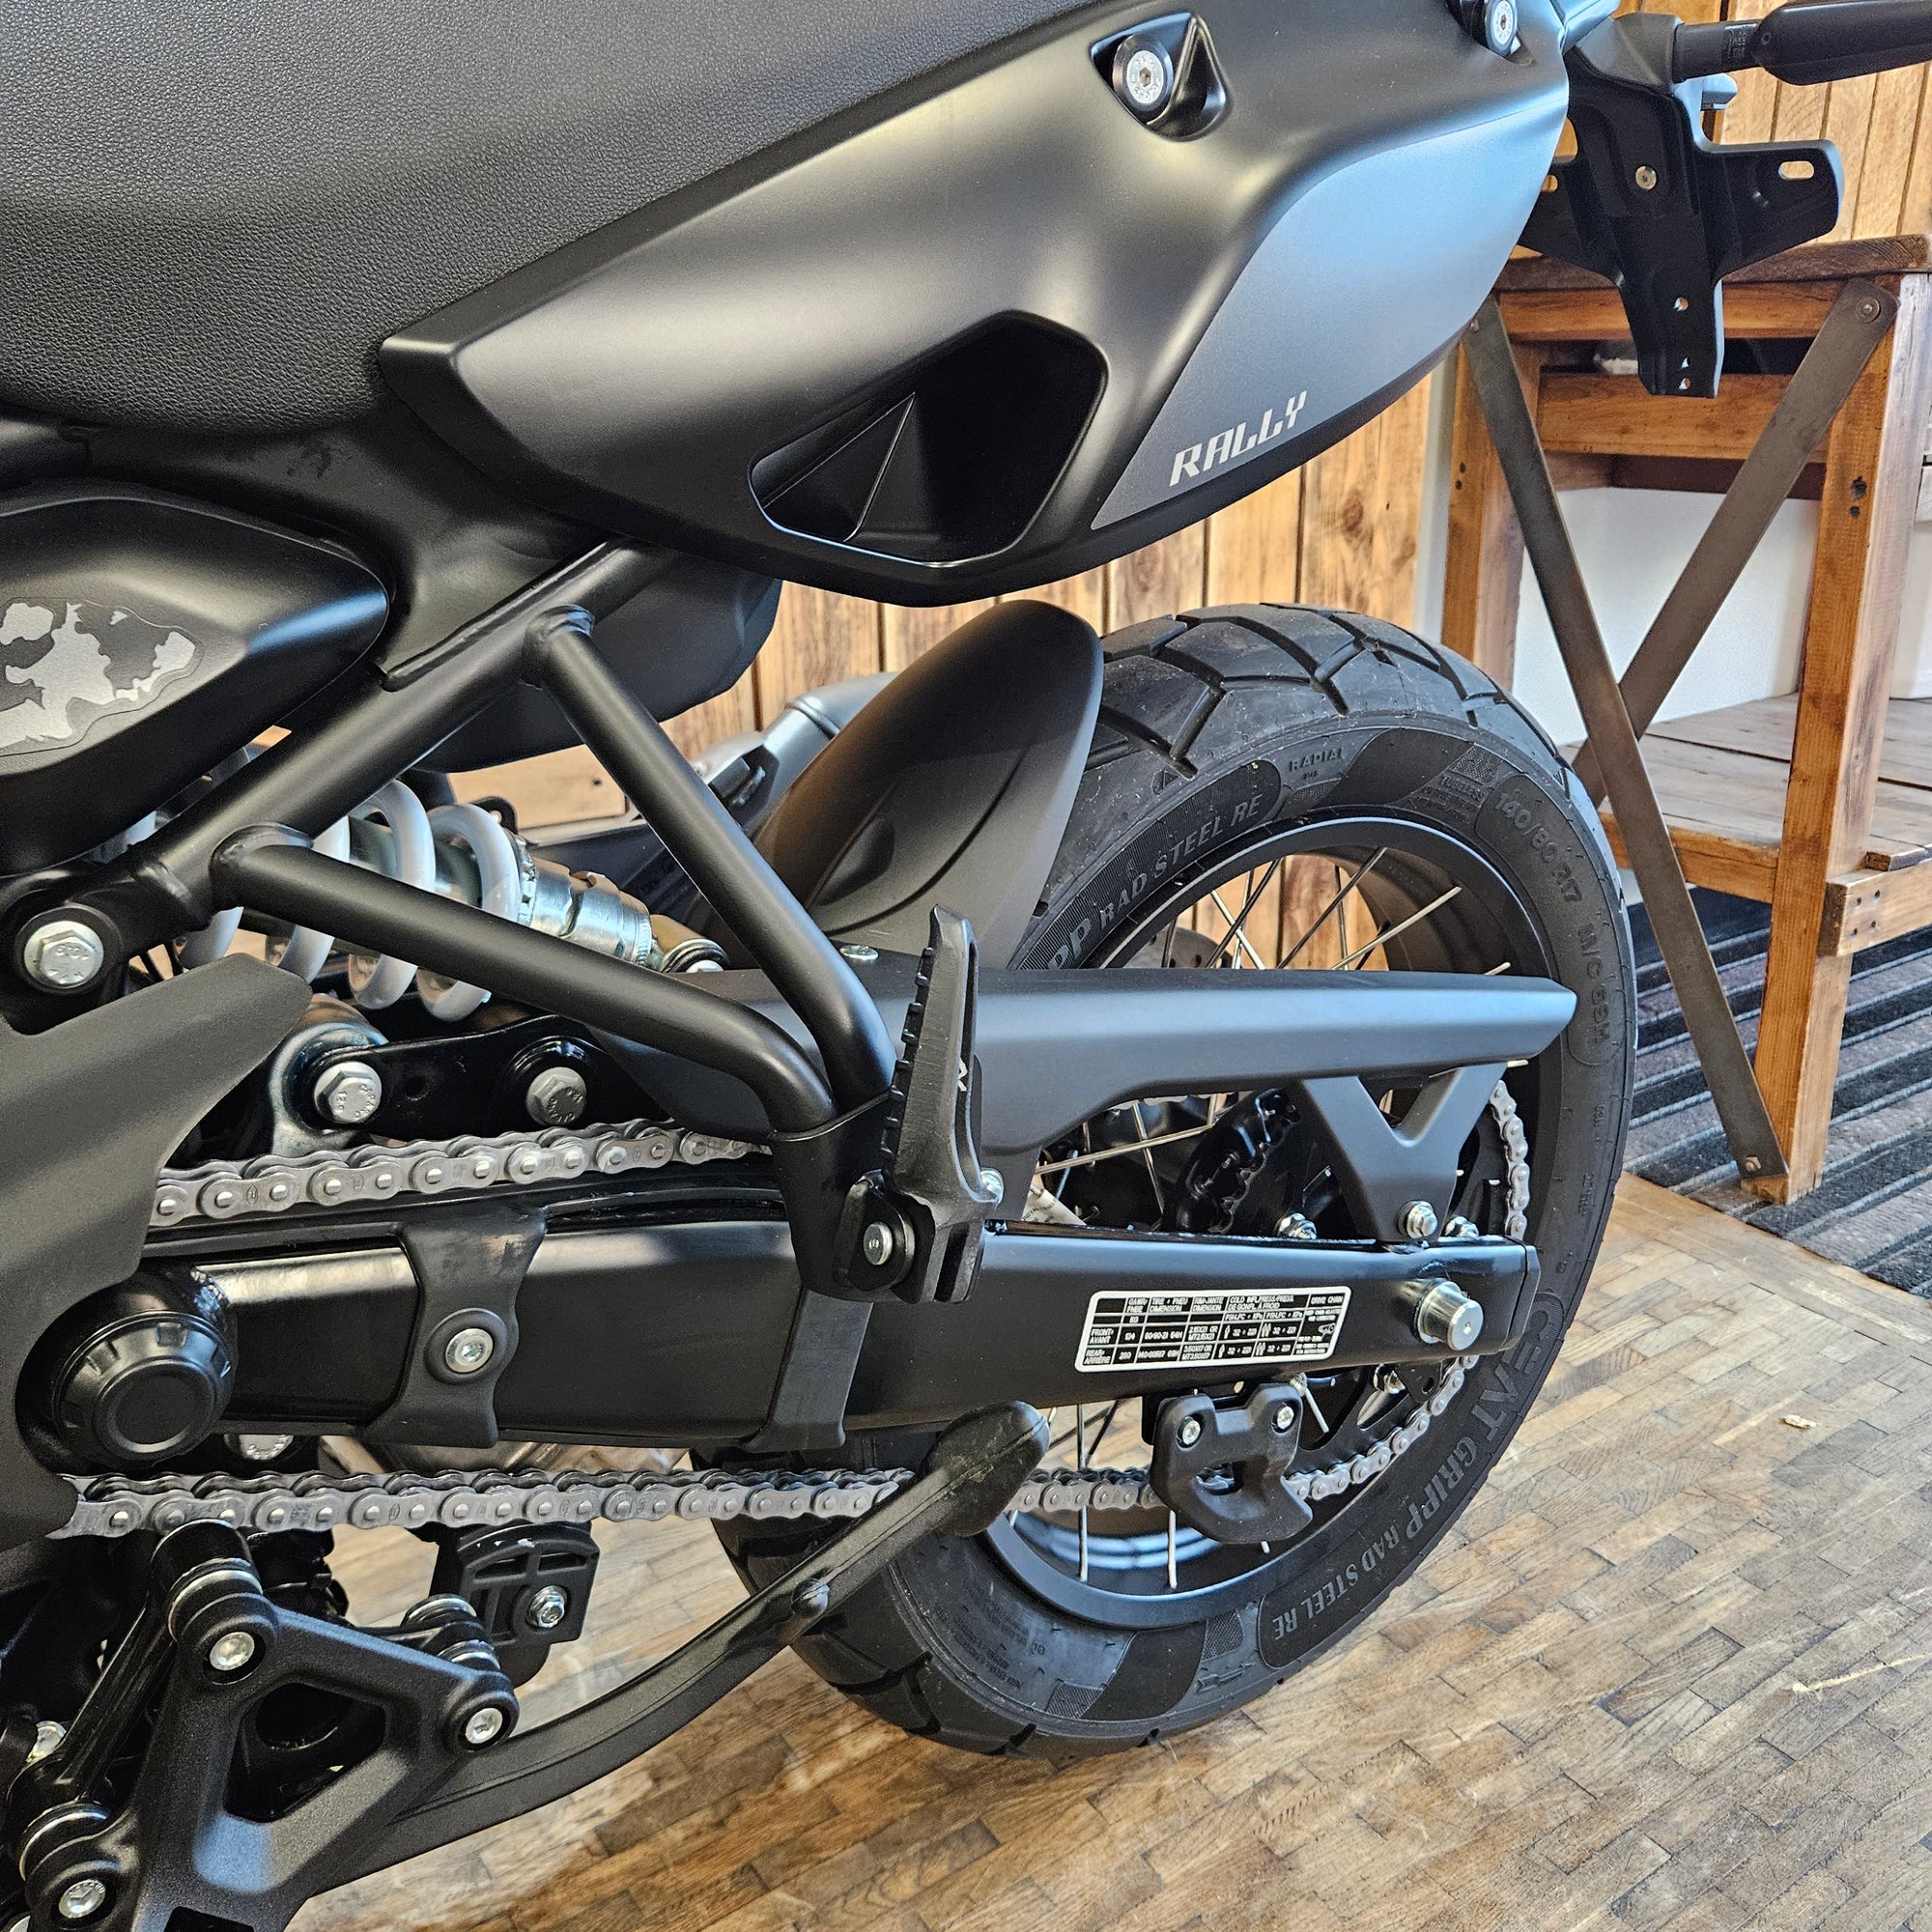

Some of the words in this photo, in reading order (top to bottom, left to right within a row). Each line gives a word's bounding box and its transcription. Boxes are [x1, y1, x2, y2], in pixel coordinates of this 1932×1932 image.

[1170, 390, 1307, 487] RALLY
[1289, 746, 1346, 772] RADIAL
[1098, 872, 1148, 929] RAD
[1153, 816, 1223, 879] STEEL
[1231, 793, 1264, 827] RE
[1406, 1436, 1477, 1538] GRIPP
[1362, 1525, 1401, 1573] RAD
[1306, 1562, 1359, 1619] STEEL
[1272, 1615, 1298, 1640] RE
